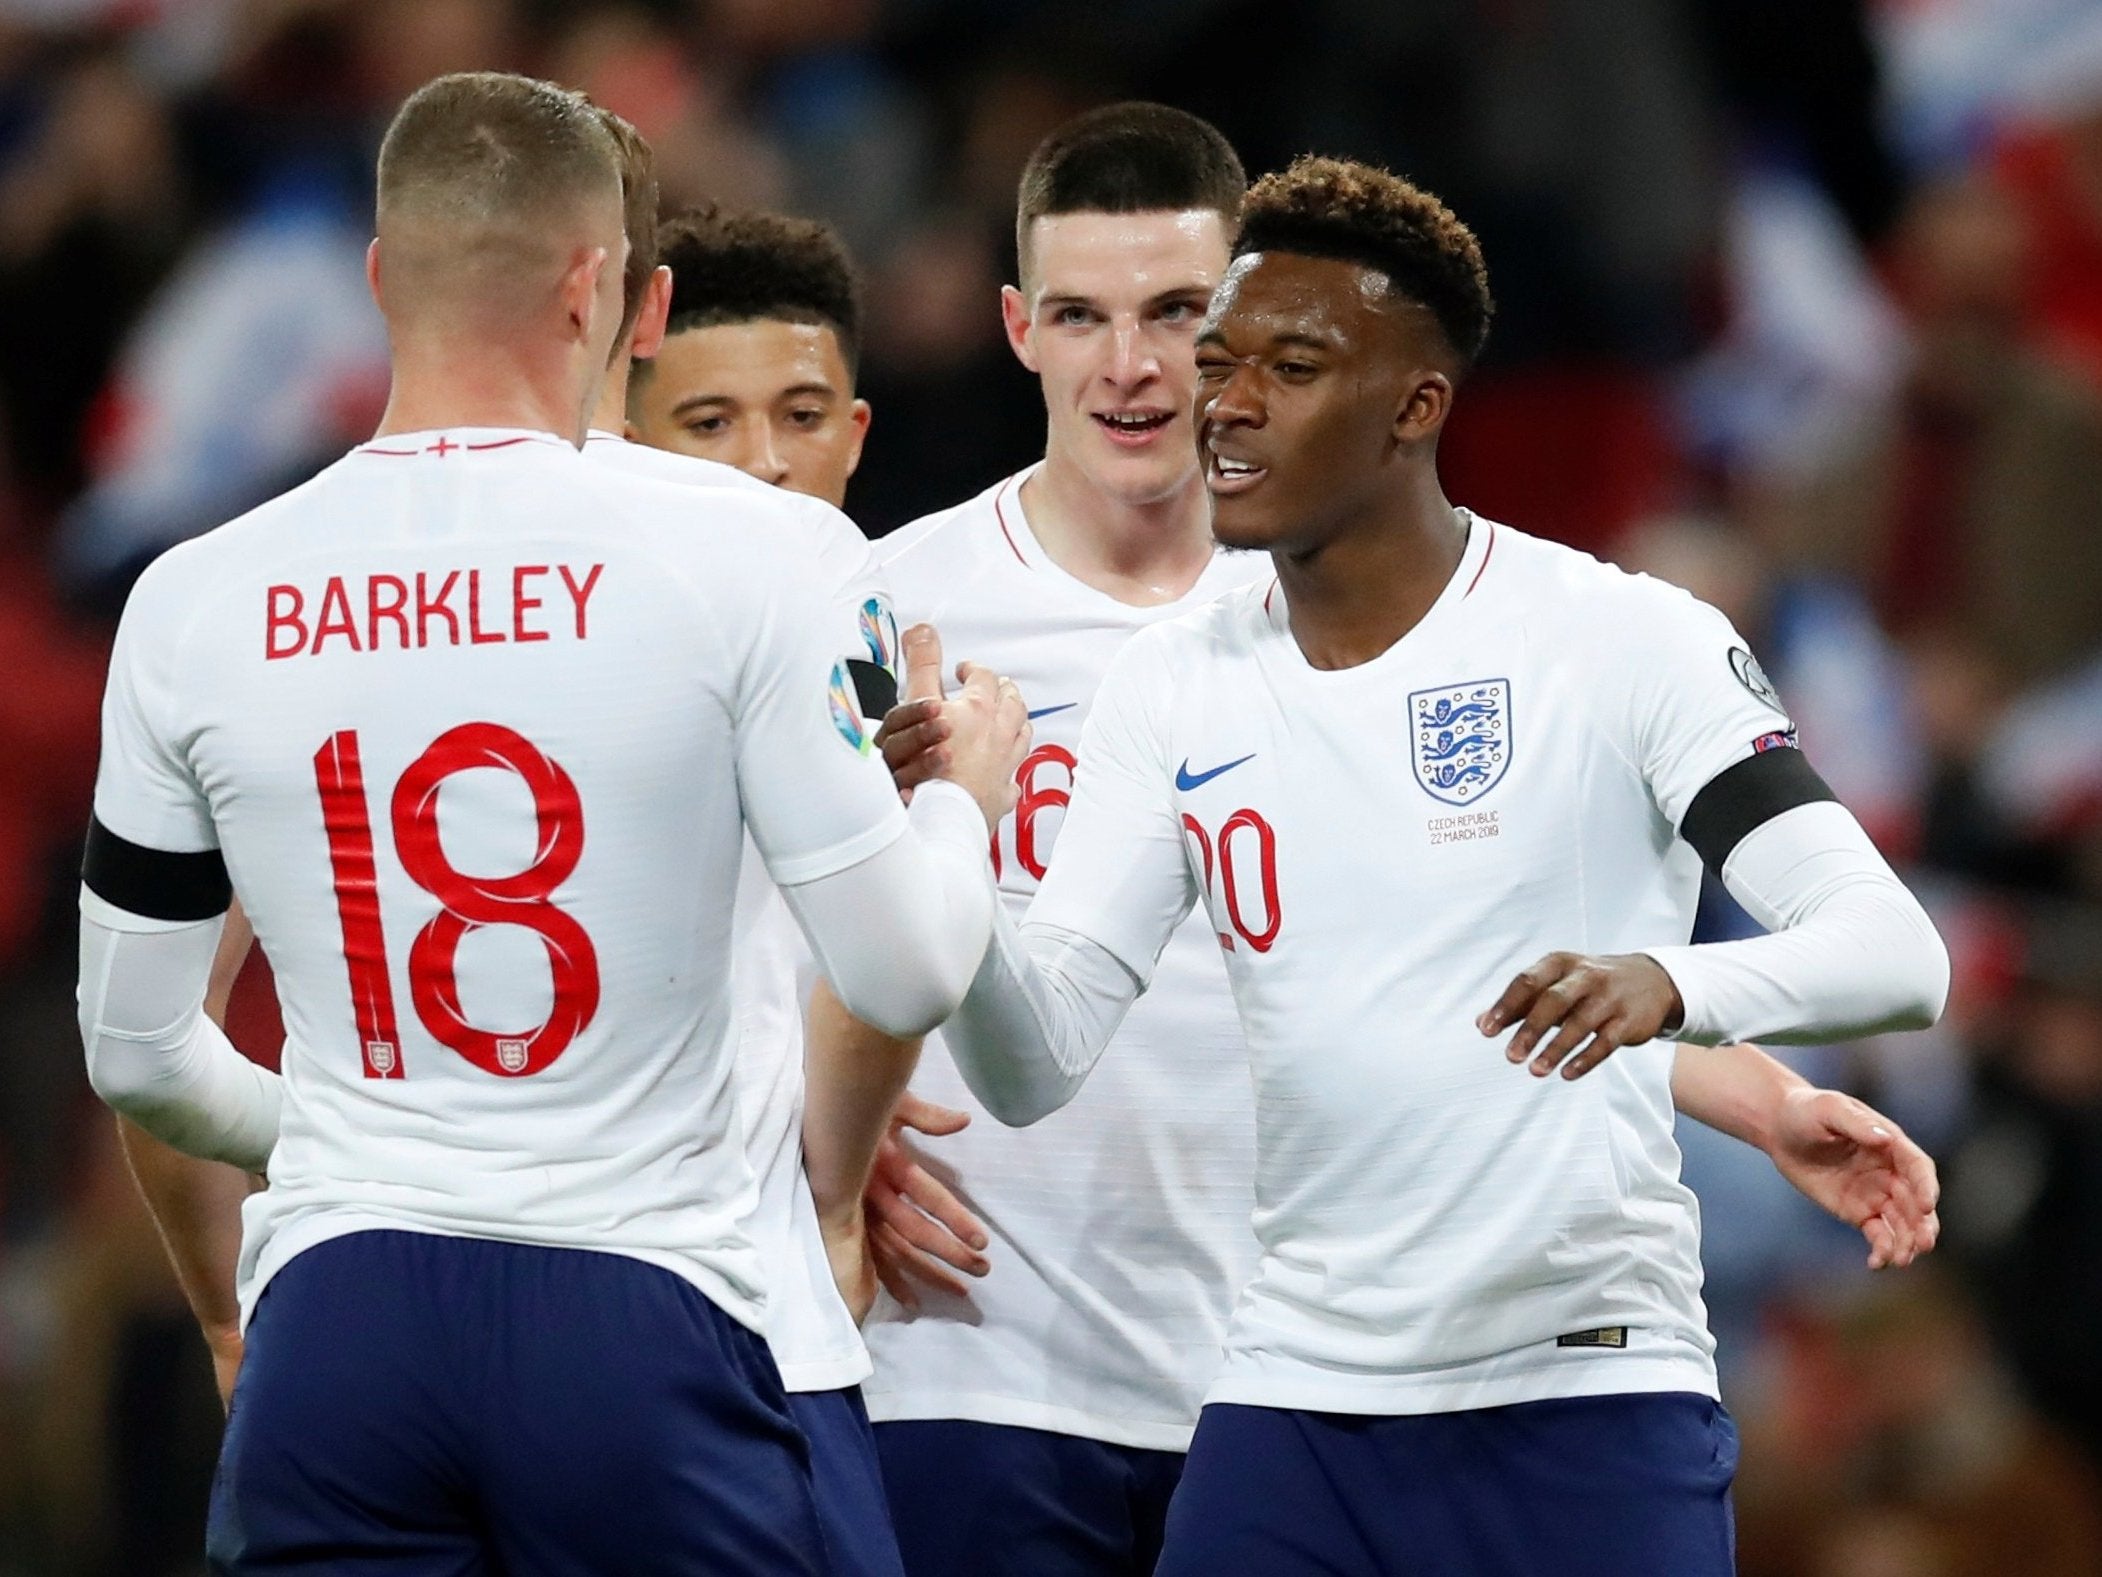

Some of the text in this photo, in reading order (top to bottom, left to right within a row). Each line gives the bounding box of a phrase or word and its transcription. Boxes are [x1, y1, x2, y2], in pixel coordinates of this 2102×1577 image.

[266, 563, 605, 660] BARKLEY
[990, 743, 1078, 883] 6
[1427, 810, 1499, 831] CZECH REPUBLIC
[1430, 824, 1499, 845] 22 MARCH 2019
[313, 721, 601, 1078] 18
